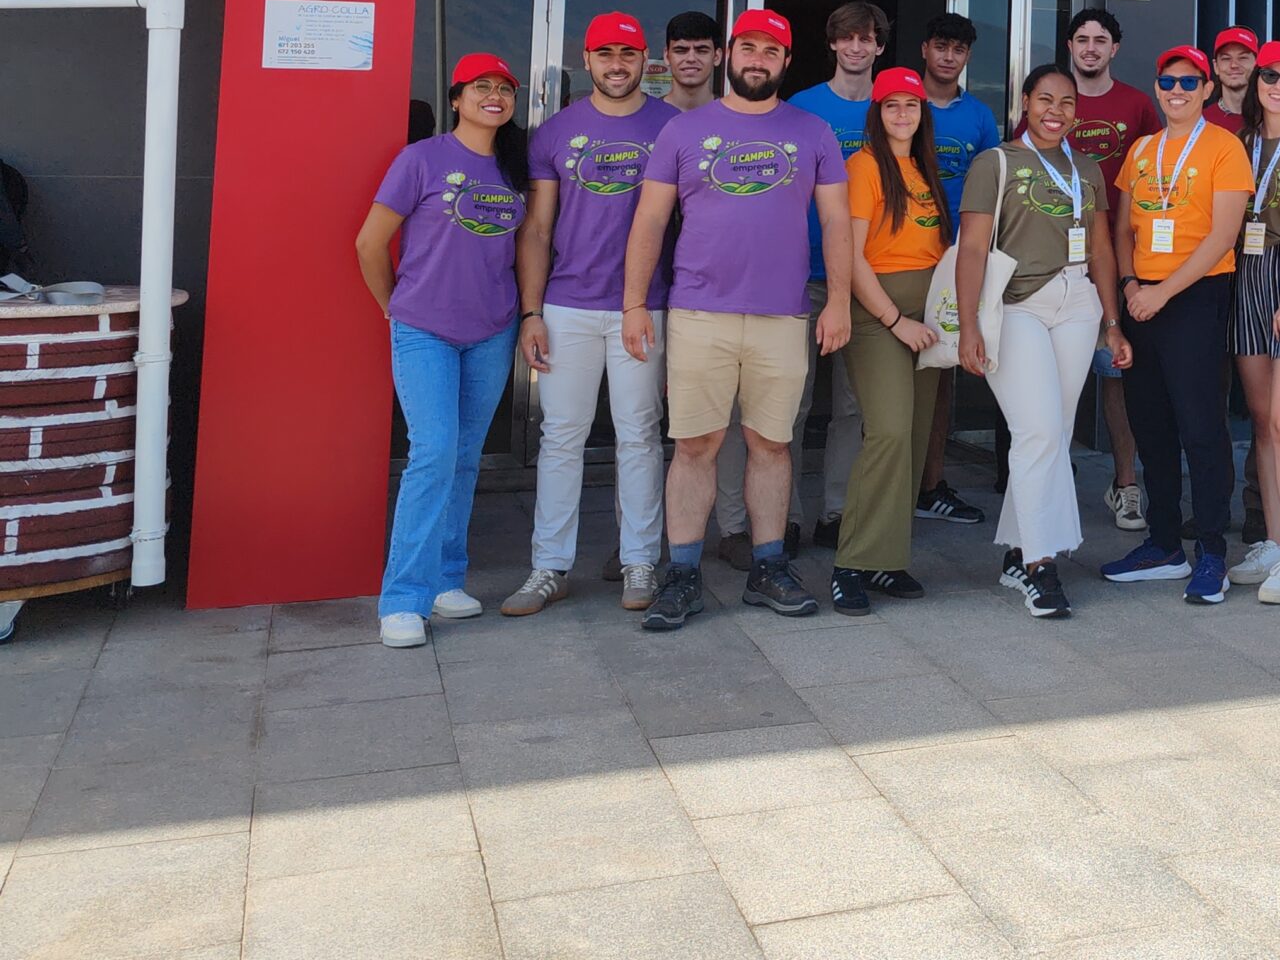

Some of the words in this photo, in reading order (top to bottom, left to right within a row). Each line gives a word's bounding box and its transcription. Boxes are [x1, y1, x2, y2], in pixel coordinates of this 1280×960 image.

[1082, 127, 1110, 137] CAMPUS
[595, 154, 602, 163] II
[603, 150, 640, 163] CAMPUS
[730, 155, 737, 164] II
[739, 150, 775, 163] CAMPUS
[732, 162, 779, 172] emprende
[473, 193, 479, 202] II
[480, 193, 514, 203] CAMPUS
[474, 204, 517, 214] emprende
